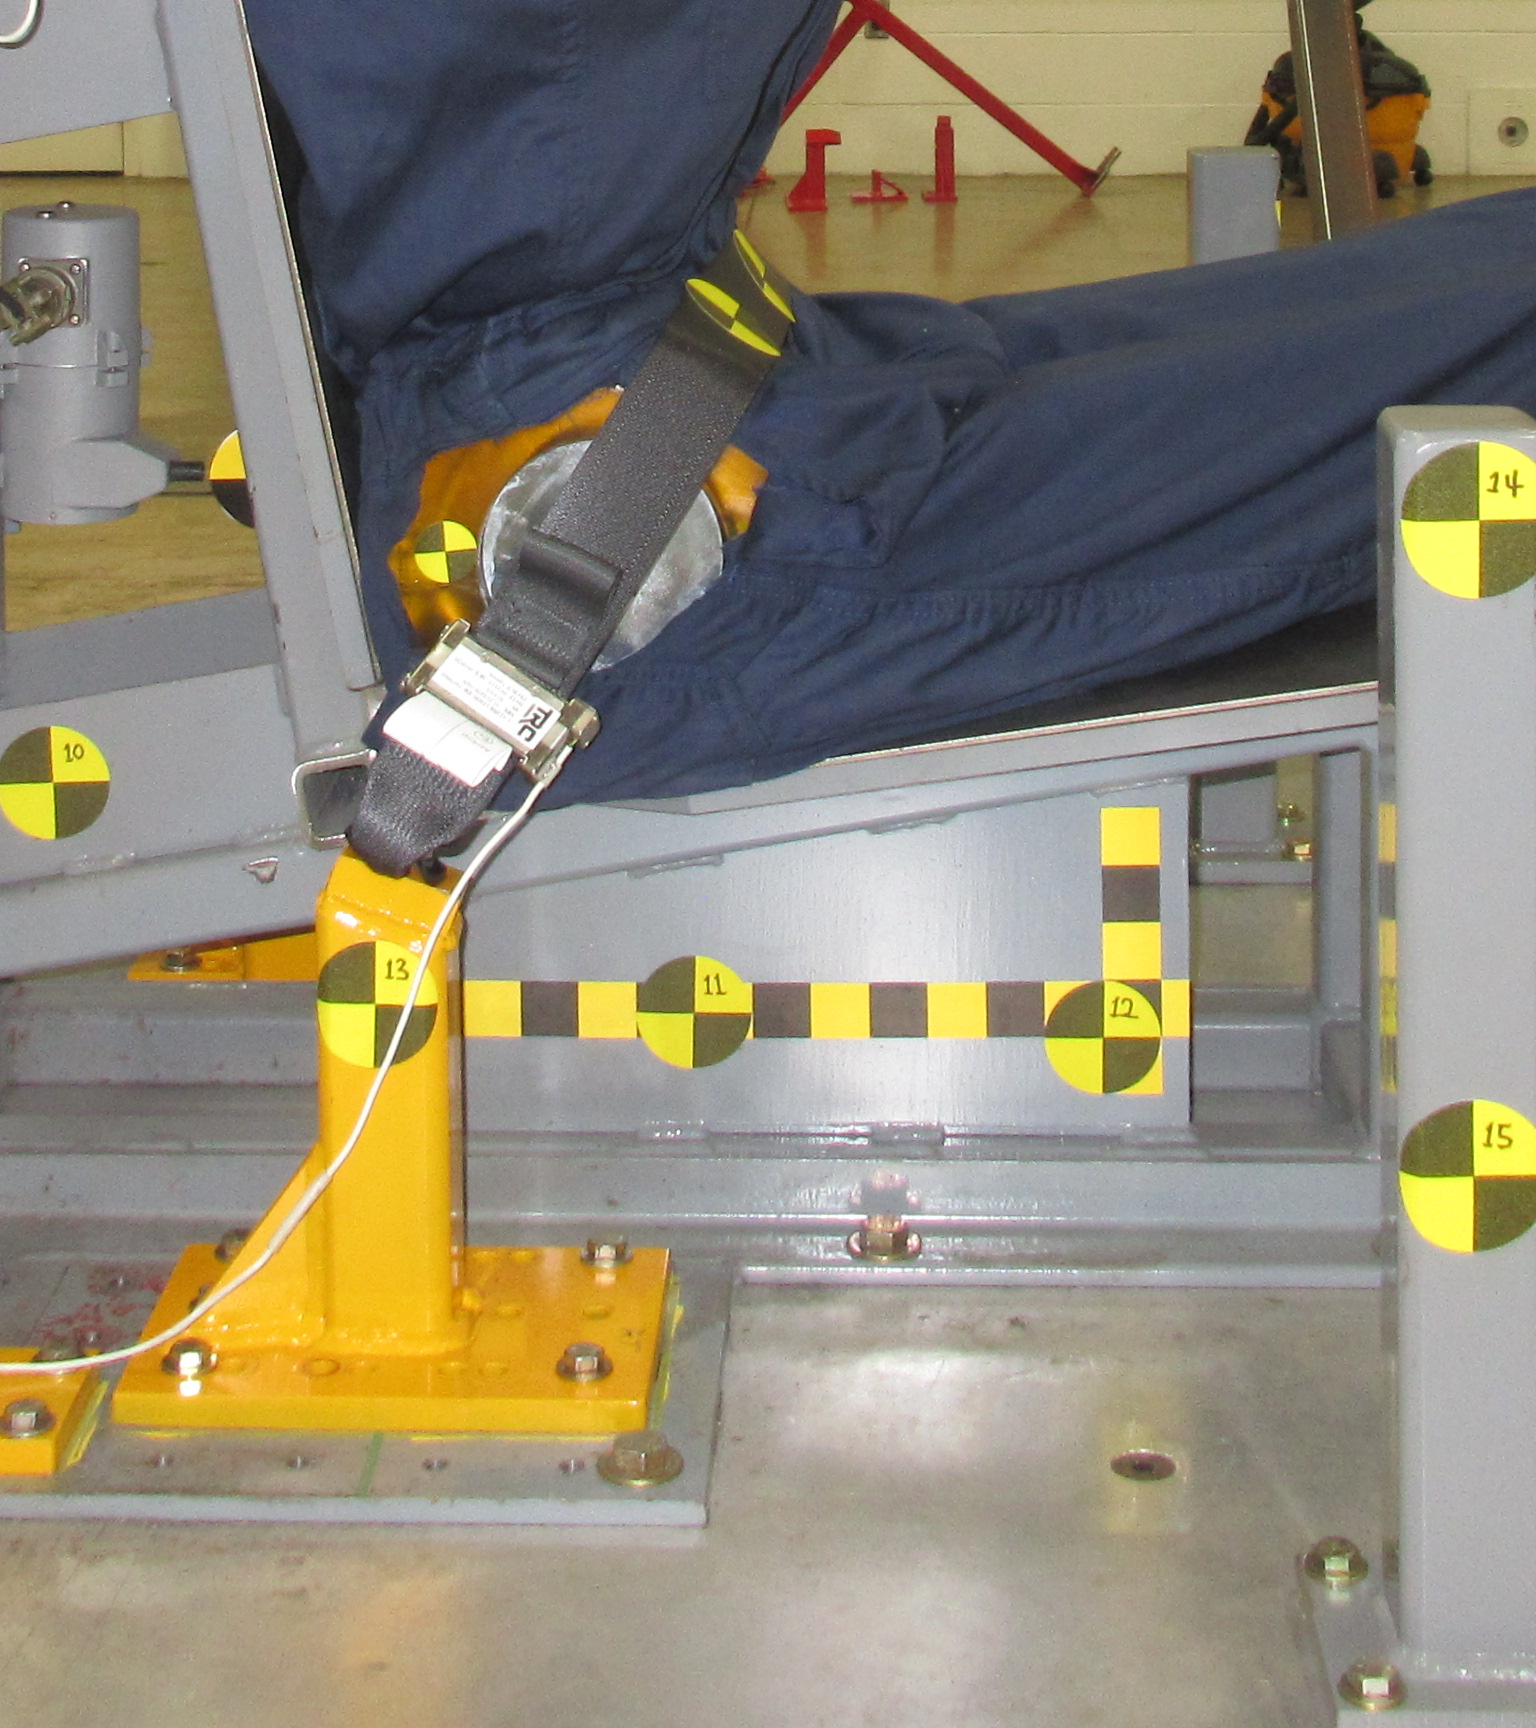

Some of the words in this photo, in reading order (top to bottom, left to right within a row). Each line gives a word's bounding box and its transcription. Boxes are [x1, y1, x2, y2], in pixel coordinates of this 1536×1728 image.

[1486, 468, 1525, 499] 14
[517, 705, 554, 742] TRC
[63, 742, 85, 763] 10
[383, 957, 410, 981] 13
[703, 972, 727, 995] 11
[1108, 995, 1140, 1020] 12
[1481, 1121, 1514, 1150] 15
